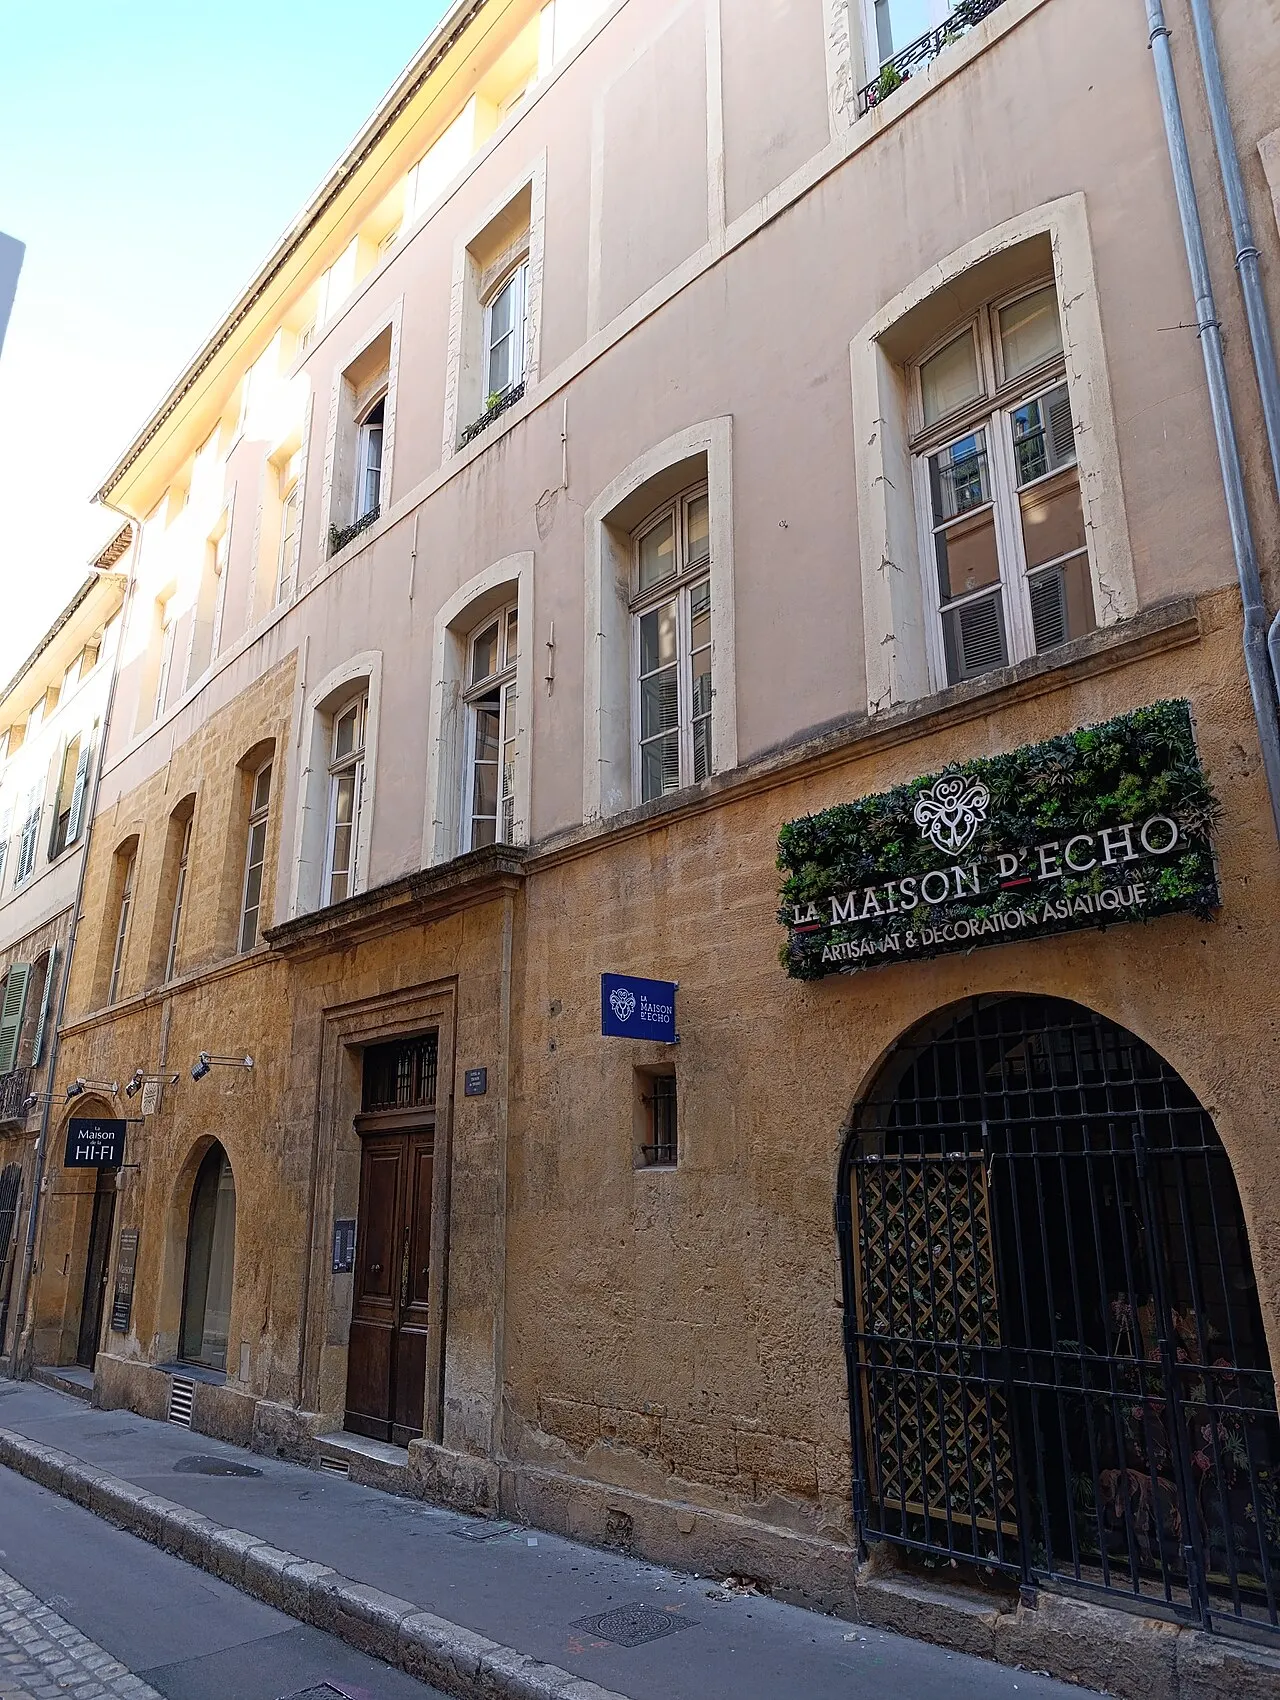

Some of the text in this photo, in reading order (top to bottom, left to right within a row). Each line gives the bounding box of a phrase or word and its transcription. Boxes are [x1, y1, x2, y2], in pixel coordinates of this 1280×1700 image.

[792, 816, 1178, 926] LA MAISON D'ECHO
[821, 933, 900, 962] ARTISANAT
[905, 930, 918, 948] &
[1042, 883, 1147, 922] ASIATIQUE
[640, 1002, 673, 1015] MAISON
[640, 1011, 670, 1023] D'ECHO
[77, 1129, 115, 1139] Maison
[75, 1145, 114, 1160] HI-FI
